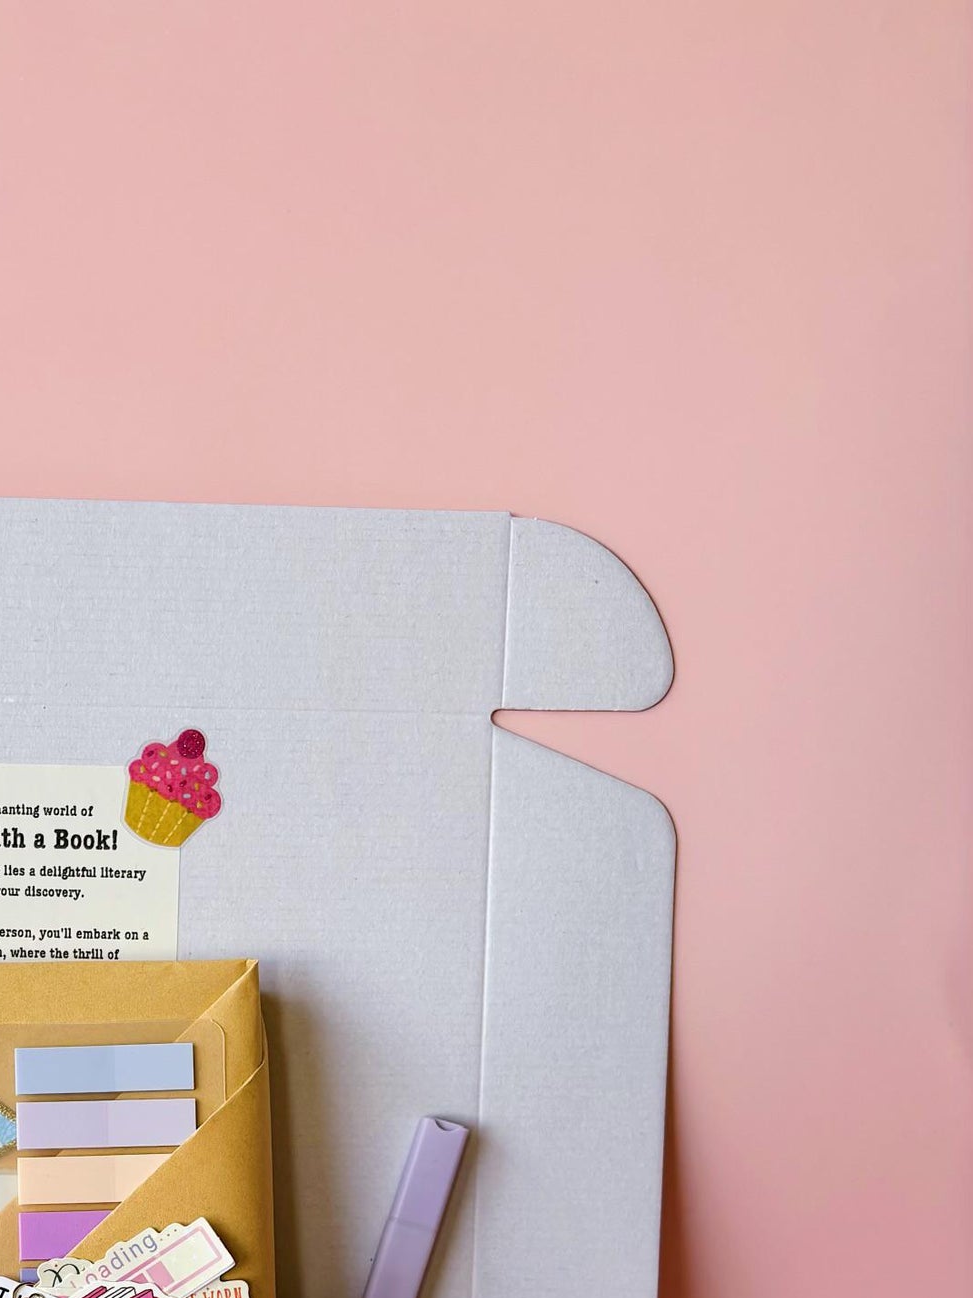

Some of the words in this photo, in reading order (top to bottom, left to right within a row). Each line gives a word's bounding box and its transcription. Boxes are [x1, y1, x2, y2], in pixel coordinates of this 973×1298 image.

[42, 804, 78, 817] world
[80, 805, 94, 817] of
[33, 833, 46, 849] a
[53, 828, 118, 851] Book!
[3, 864, 26, 877] lies
[29, 867, 36, 877] a
[39, 865, 97, 881] delightful
[100, 866, 147, 882] literary
[24, 885, 85, 901] discovery.
[38, 927, 72, 941] you'll
[75, 928, 121, 940] embark
[124, 931, 139, 941] on
[142, 931, 149, 941] a
[9, 946, 47, 959] where
[49, 947, 69, 959] the
[72, 948, 104, 960] thrill
[107, 948, 120, 961] of
